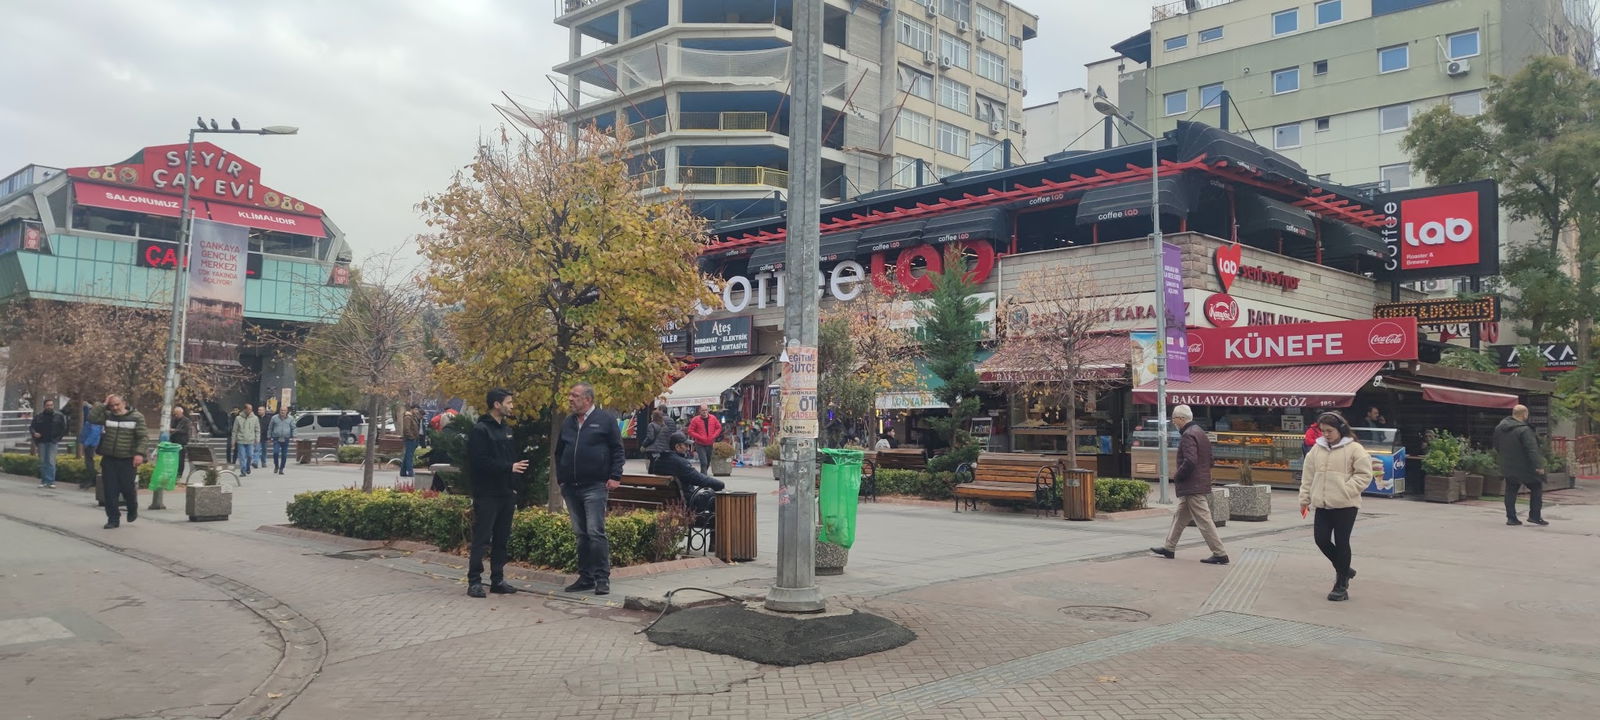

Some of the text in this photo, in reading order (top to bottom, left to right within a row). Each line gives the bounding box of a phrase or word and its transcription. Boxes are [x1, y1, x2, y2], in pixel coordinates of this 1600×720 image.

[166, 150, 243, 178] SEYİR
[152, 169, 254, 199] ÇAY EVİ
[105, 192, 180, 208] SALONUMUZ
[1029, 193, 1064, 205] coffee lab
[238, 211, 296, 226] KLİMALIDIR
[1098, 211, 1122, 220] coffee
[760, 263, 774, 271] coffee
[1420, 305, 1428, 318] &
[1430, 301, 1490, 318] DESSERTS
[712, 320, 731, 336] Ateş
[1225, 332, 1343, 359] KÜNEFE
[1172, 394, 1238, 406] BAKLAVACI
[1243, 395, 1307, 407] KARAGÖZ
